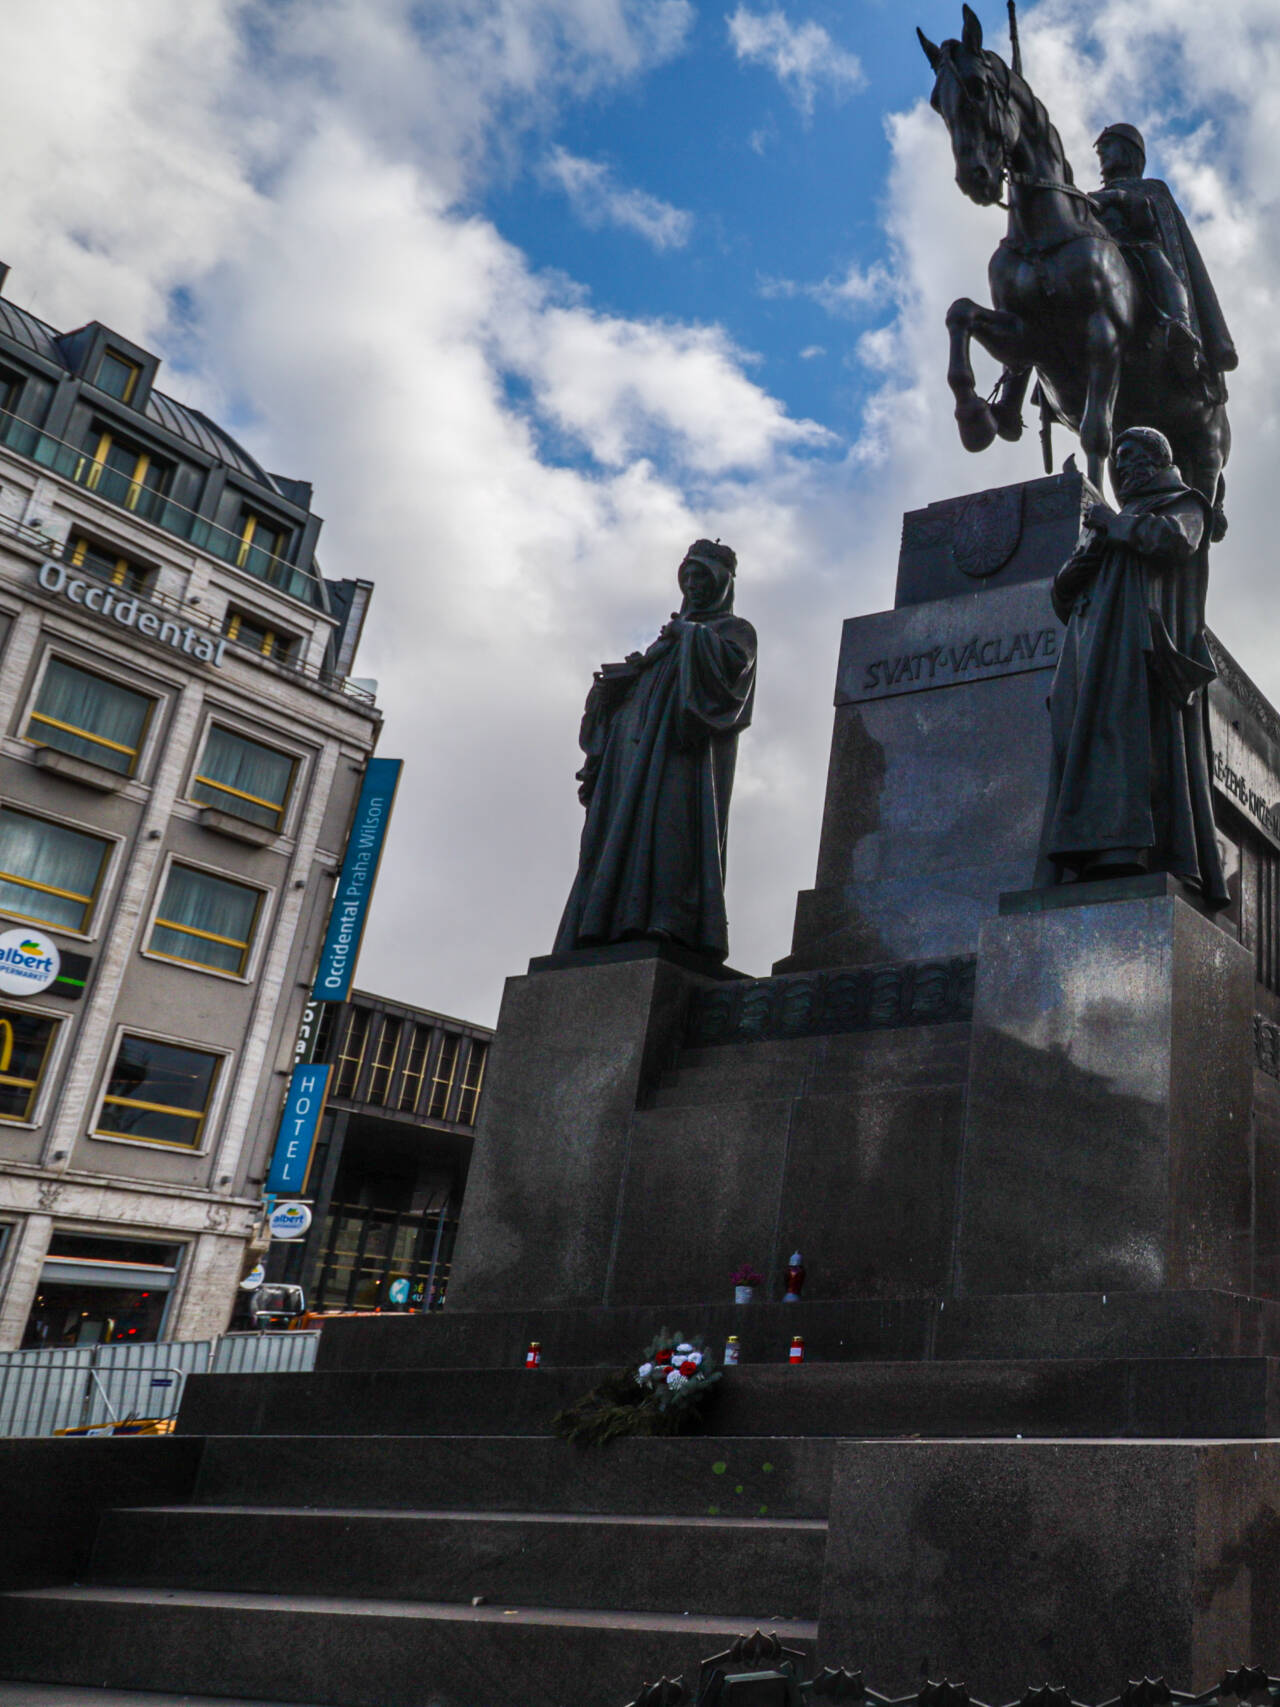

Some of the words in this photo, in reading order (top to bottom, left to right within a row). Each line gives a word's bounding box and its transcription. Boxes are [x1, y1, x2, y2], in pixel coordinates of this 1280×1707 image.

[38, 561, 227, 668] Occidental
[358, 797, 384, 848] Wilson
[346, 852, 371, 896] Praha
[325, 900, 360, 988] Occidental
[282, 1076, 316, 1182] HOTEL
[273, 1213, 305, 1225] albert
